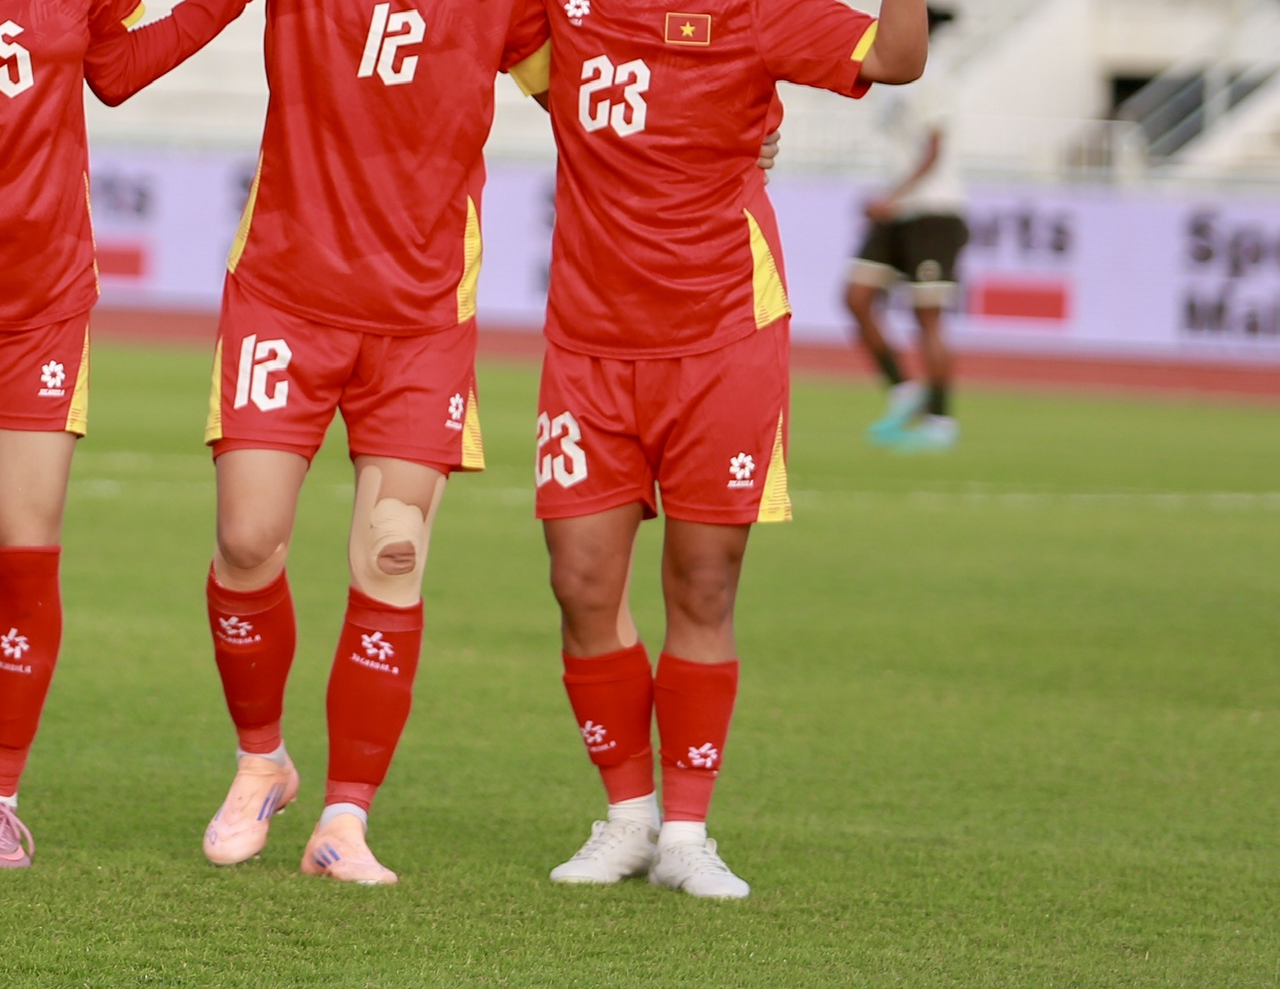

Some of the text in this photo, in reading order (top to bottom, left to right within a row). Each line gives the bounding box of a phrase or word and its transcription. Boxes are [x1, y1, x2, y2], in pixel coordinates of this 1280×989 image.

[357, 3, 426, 86] 12
[578, 55, 651, 137] 23
[234, 334, 293, 412] 12
[535, 411, 588, 488] 23
